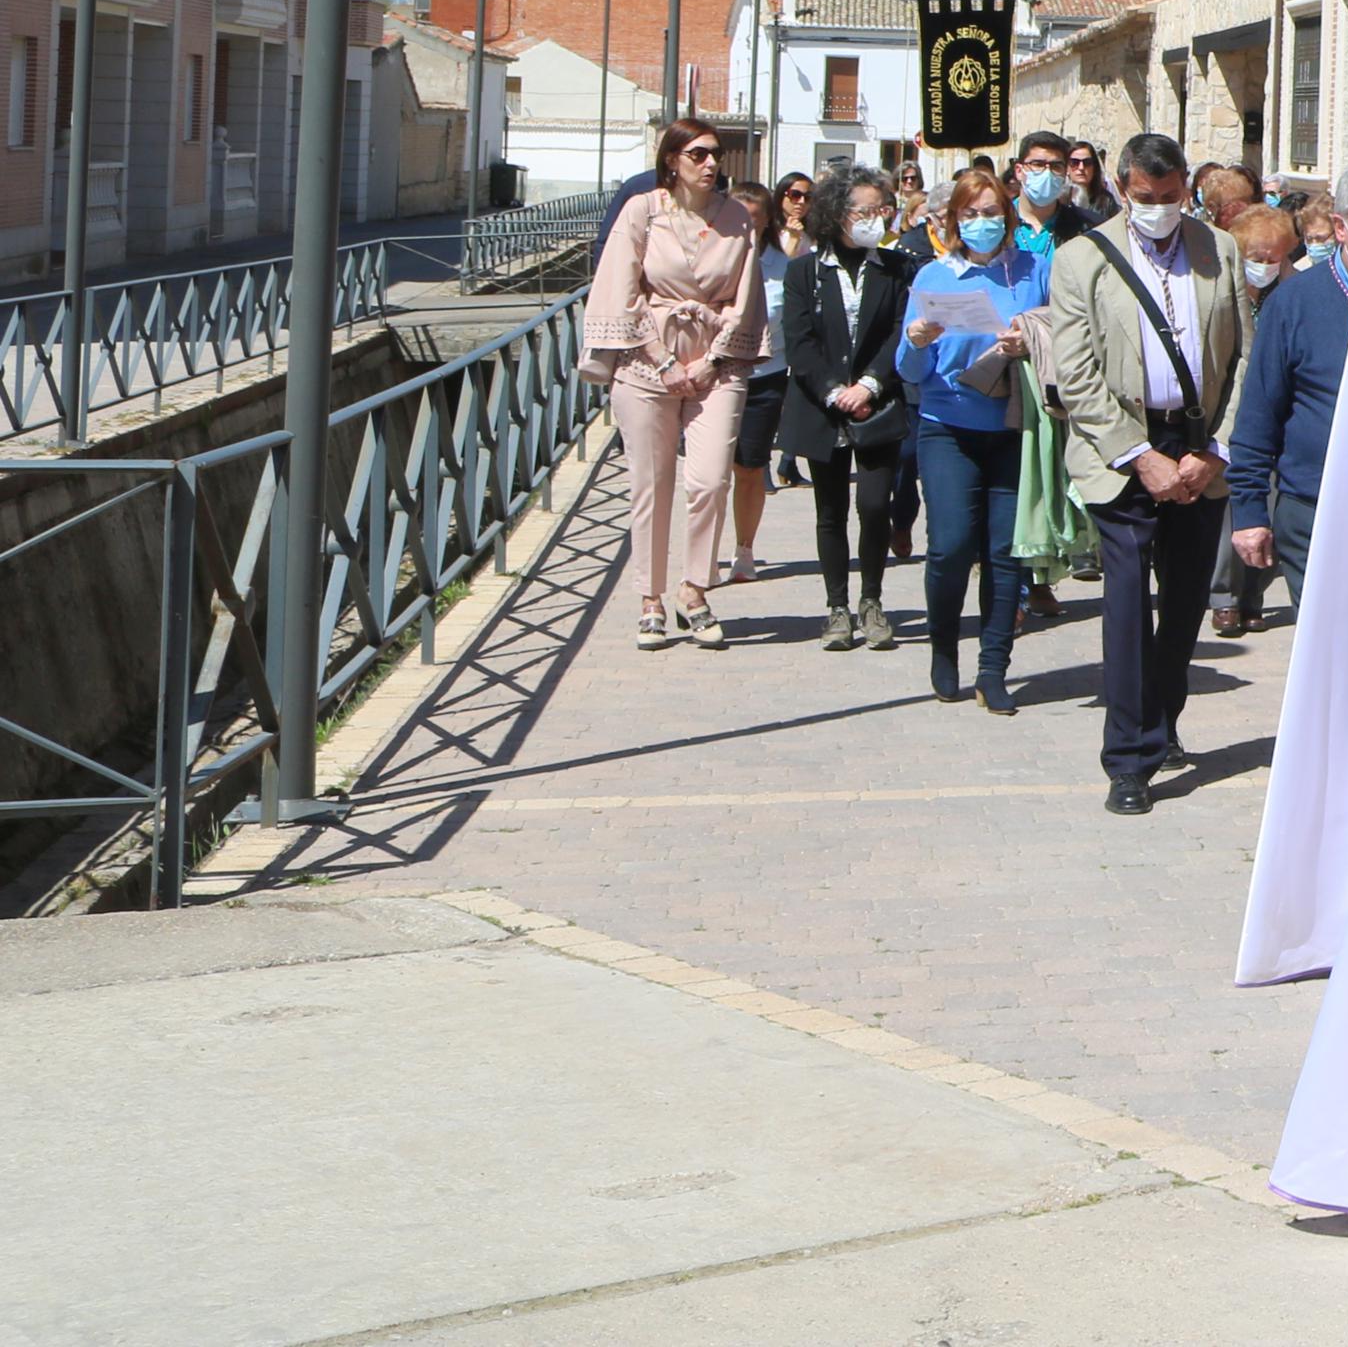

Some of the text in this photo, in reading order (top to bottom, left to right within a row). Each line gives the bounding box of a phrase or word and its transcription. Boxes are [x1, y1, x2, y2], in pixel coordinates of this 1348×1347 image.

[928, 24, 1001, 134] COFRADÍA NUESTRA SEÑORA DE LA SOLEDAD
